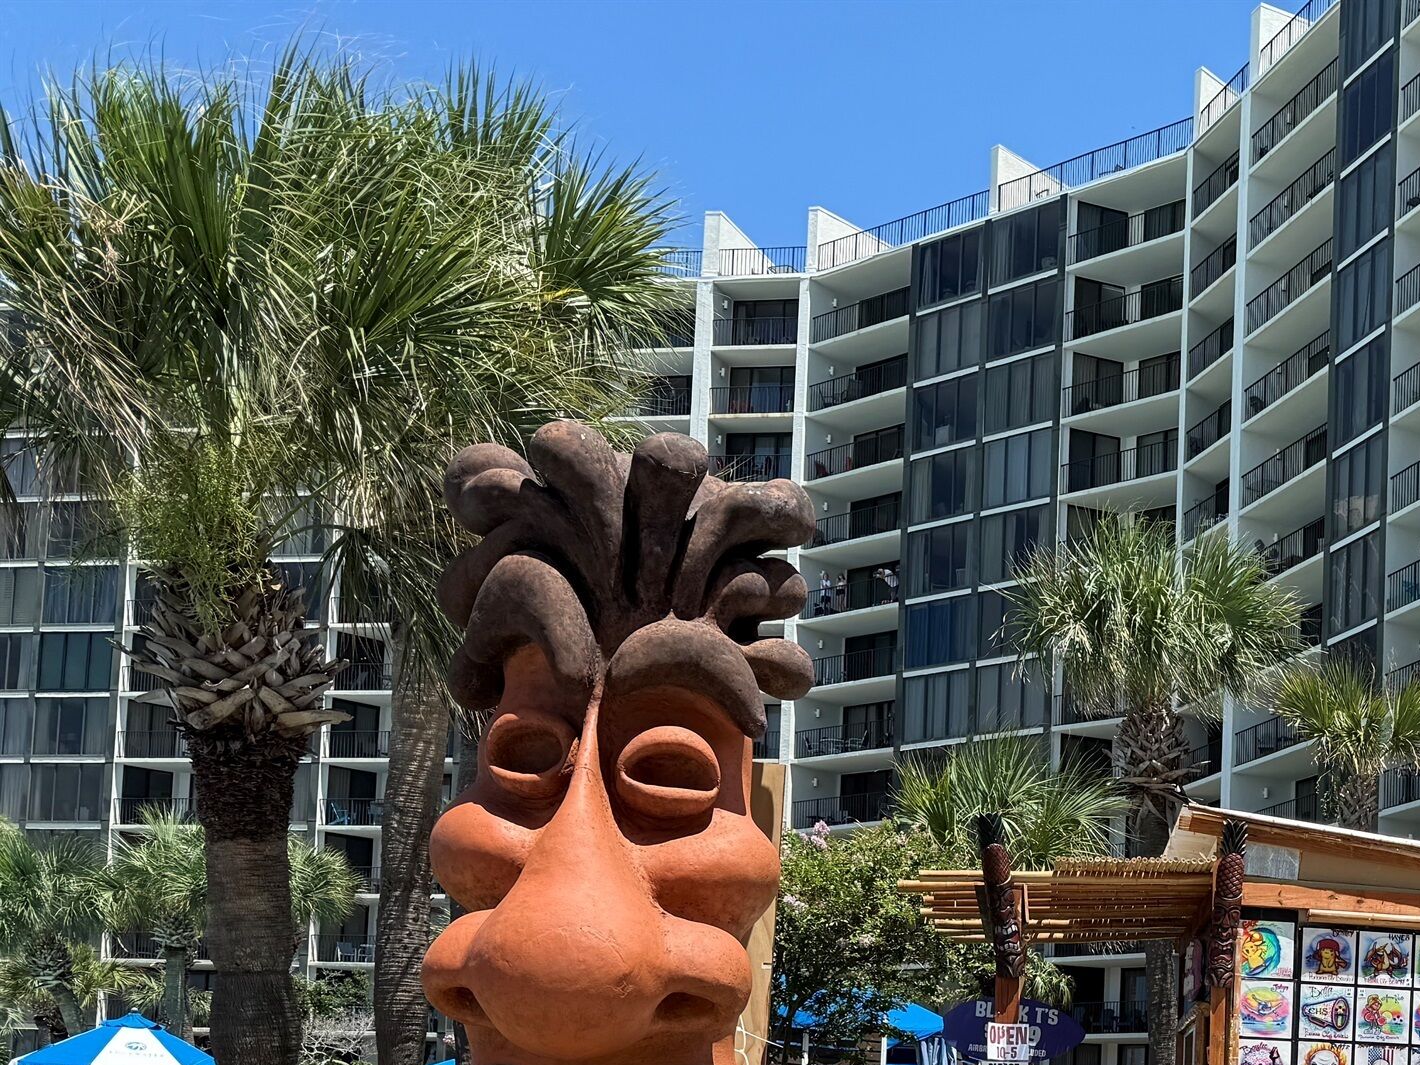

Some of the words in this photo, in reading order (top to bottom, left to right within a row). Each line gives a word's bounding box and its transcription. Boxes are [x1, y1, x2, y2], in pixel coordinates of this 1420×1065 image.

[975, 1001, 1029, 1022] BLK
[1035, 1007, 1059, 1025] T'S
[989, 1025, 1028, 1046] OPEN
[996, 1046, 1018, 1059] 10-5
